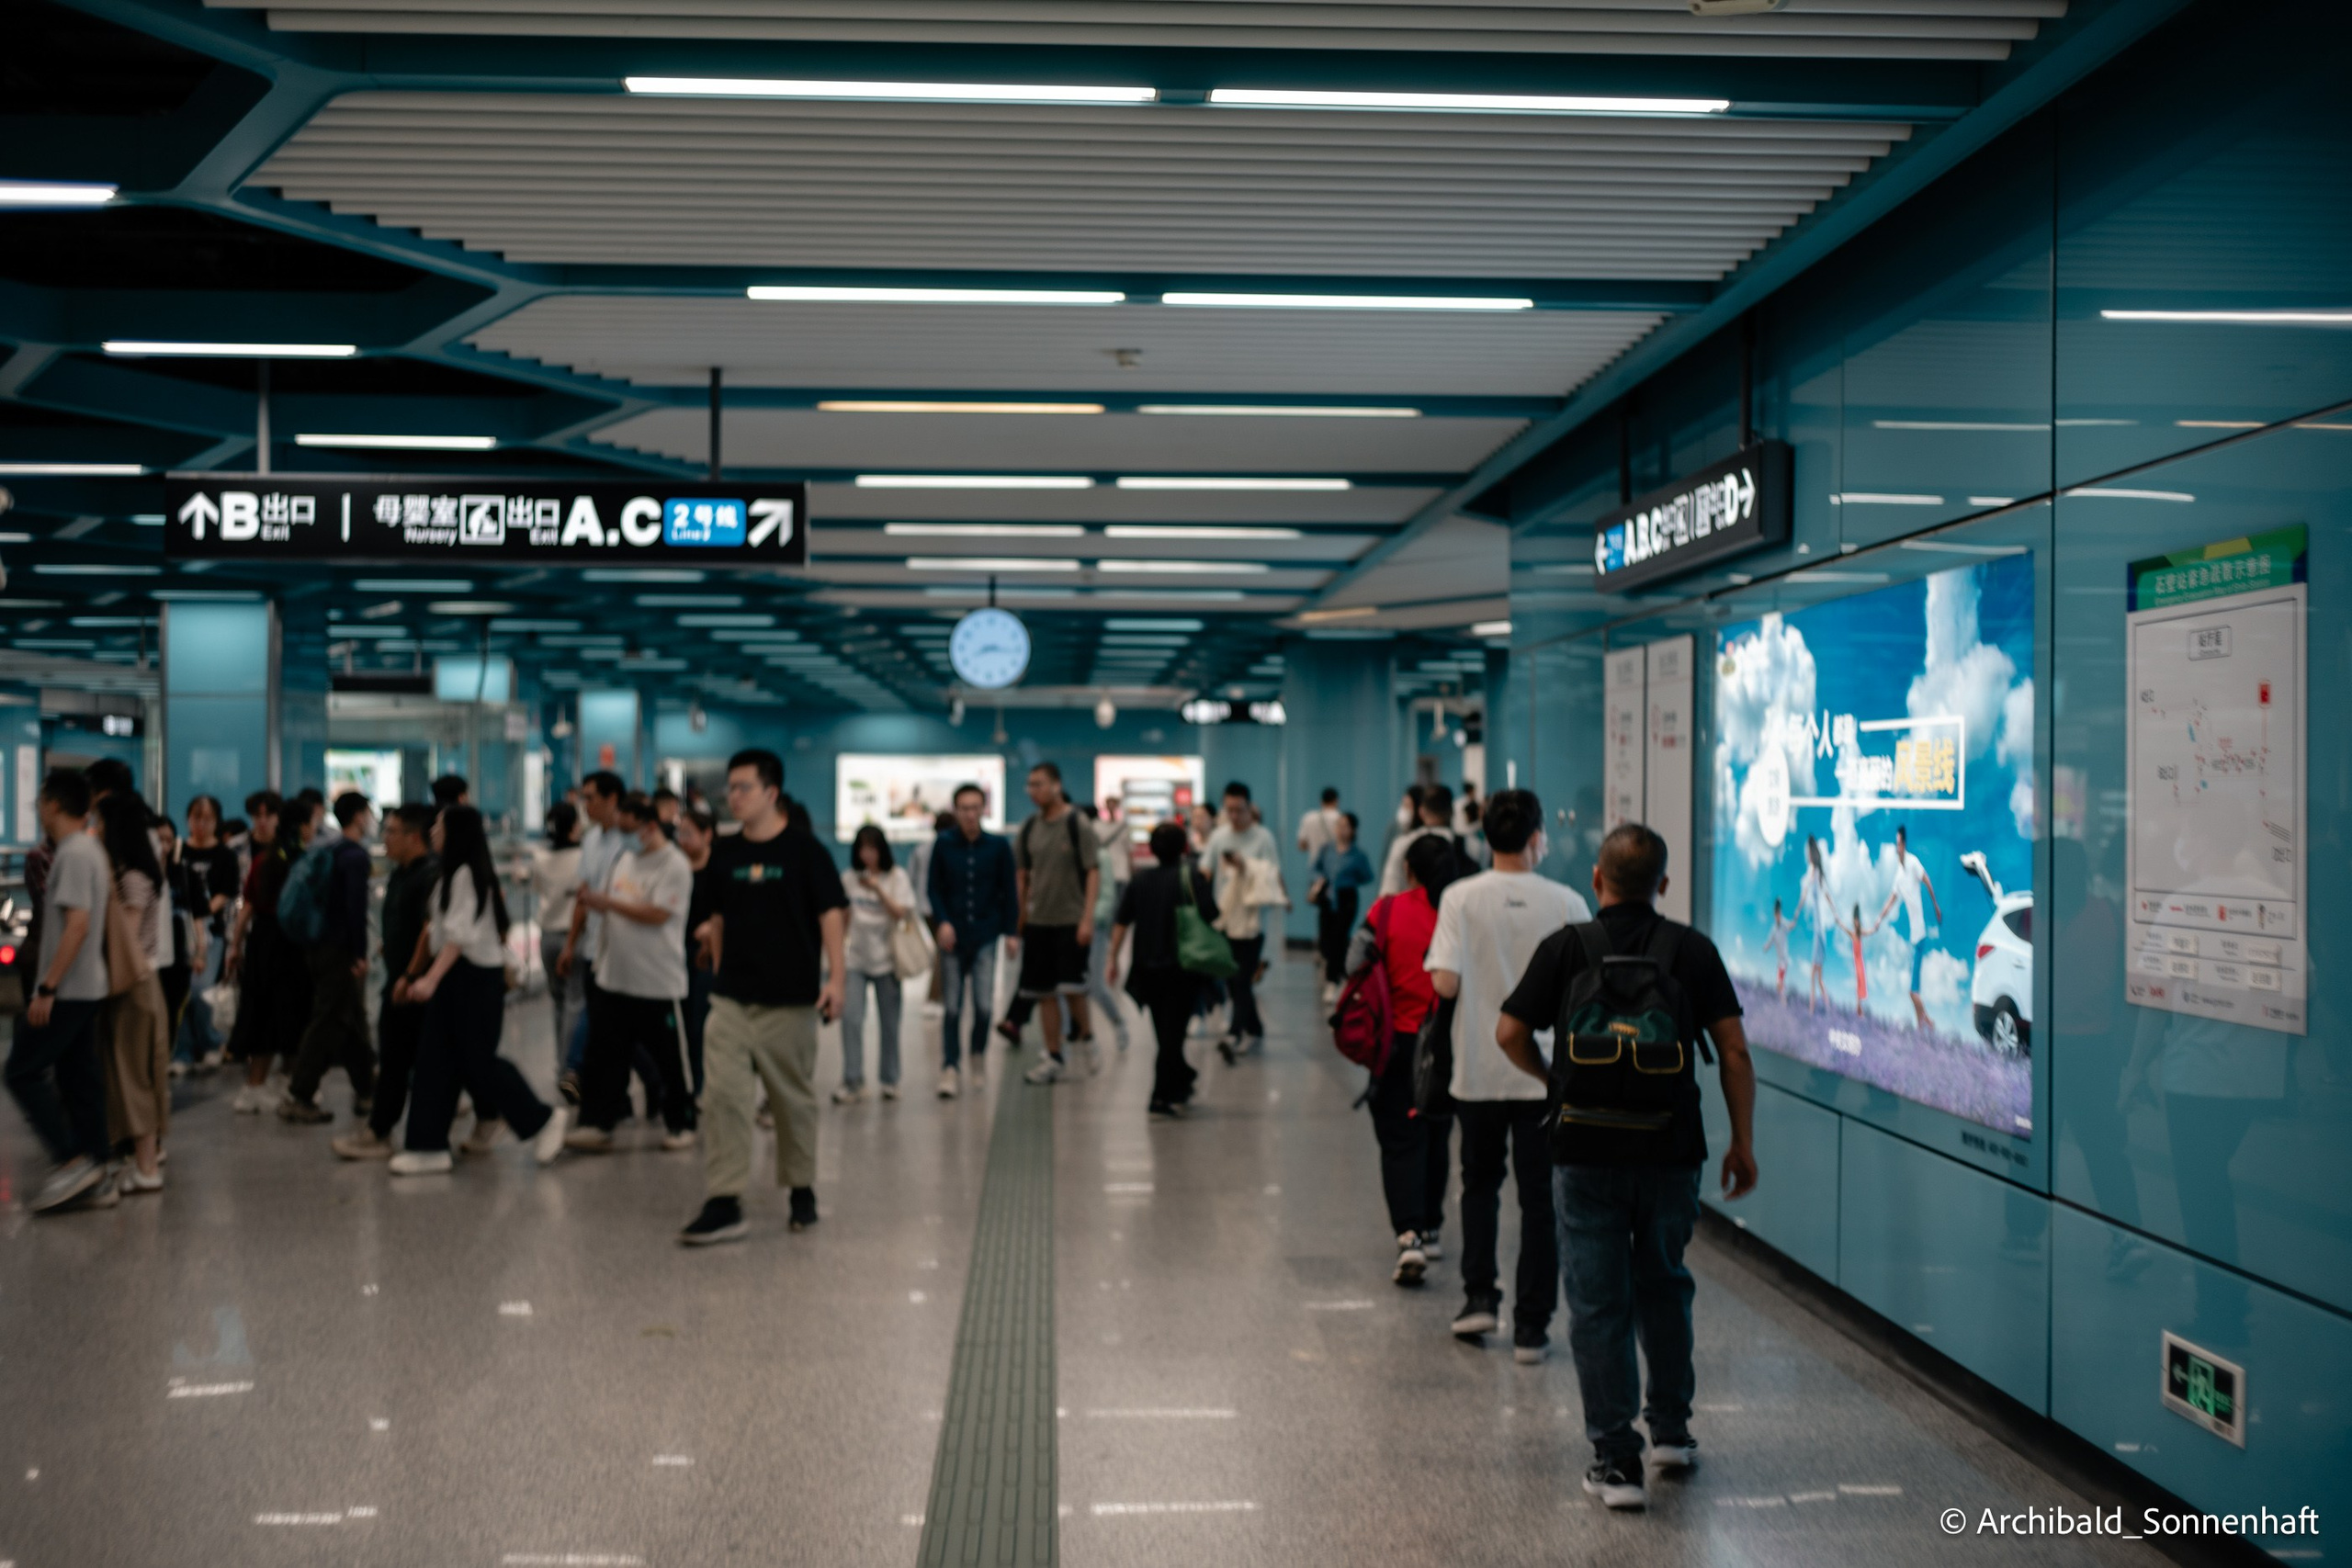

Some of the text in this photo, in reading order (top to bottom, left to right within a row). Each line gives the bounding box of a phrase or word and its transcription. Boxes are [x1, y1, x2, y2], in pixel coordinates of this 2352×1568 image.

[220, 491, 316, 541] B 出口
[506, 495, 560, 528] 出口
